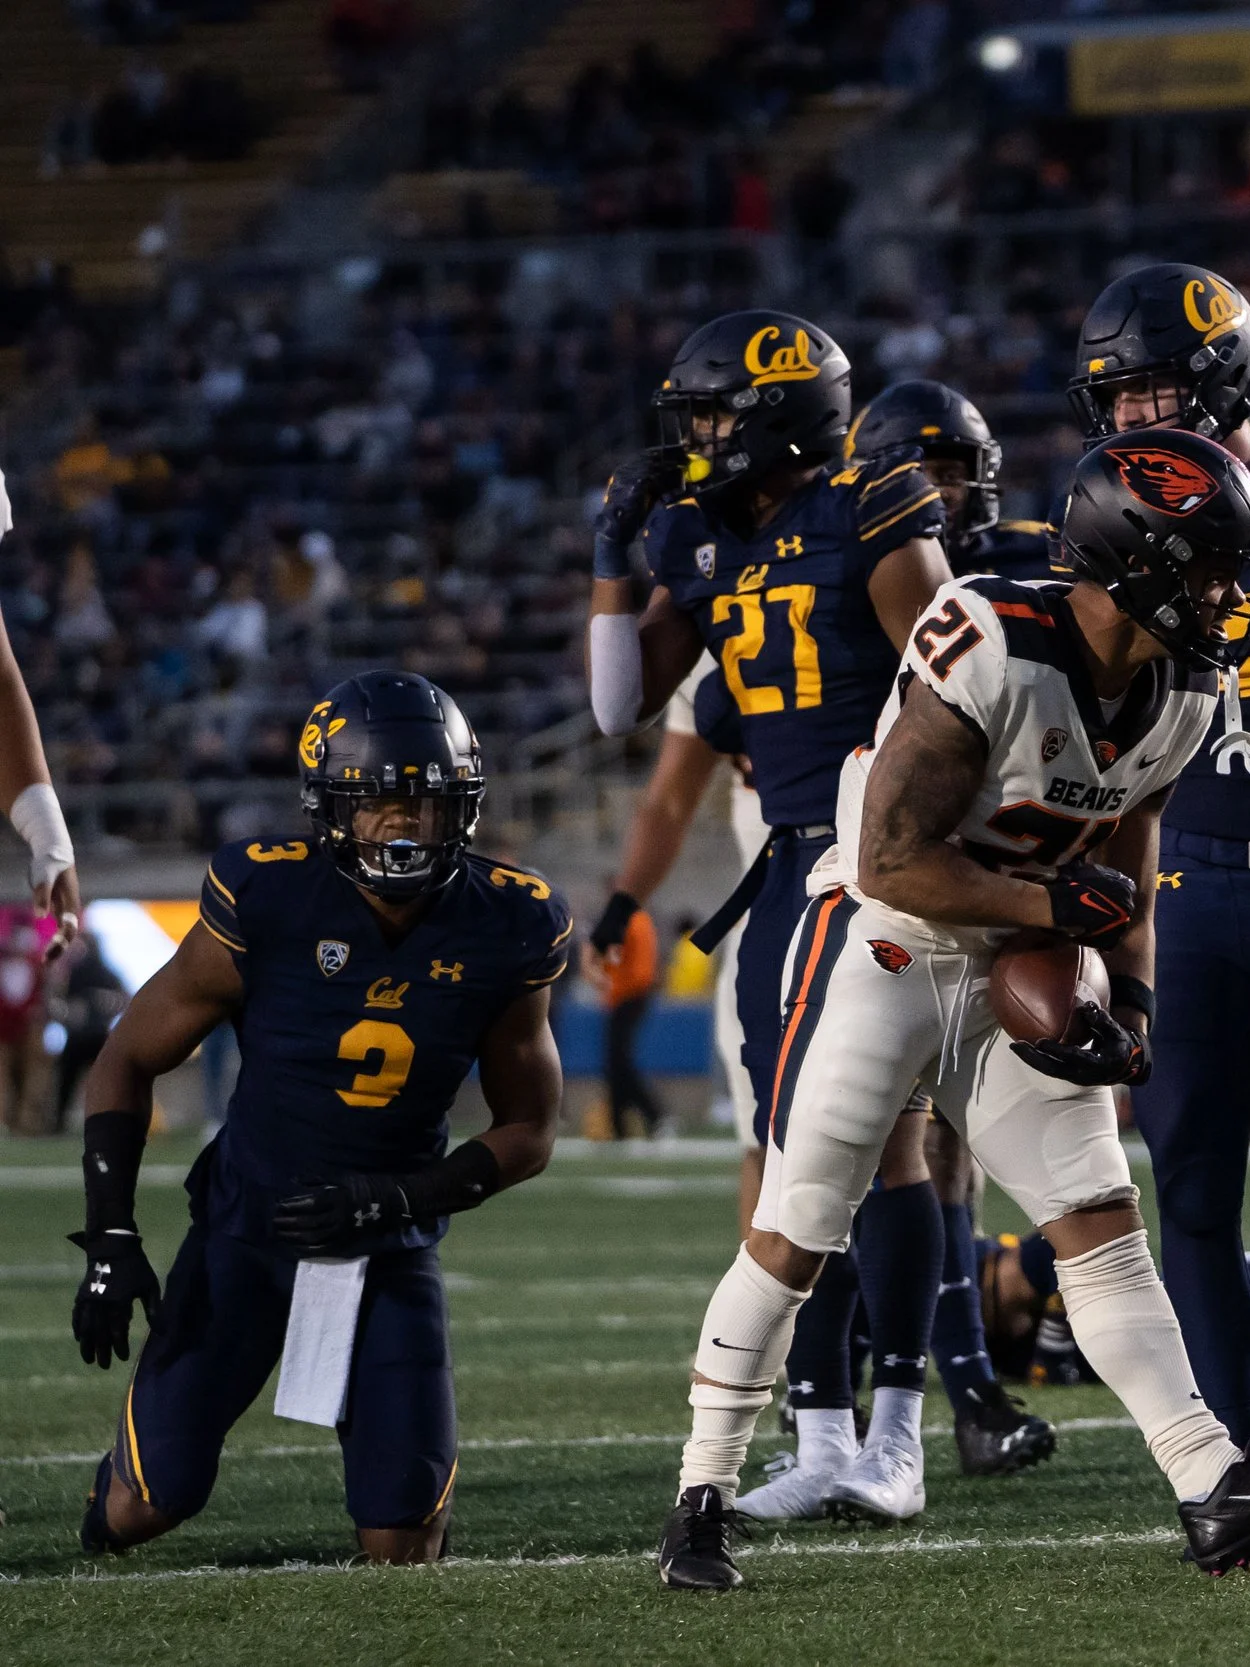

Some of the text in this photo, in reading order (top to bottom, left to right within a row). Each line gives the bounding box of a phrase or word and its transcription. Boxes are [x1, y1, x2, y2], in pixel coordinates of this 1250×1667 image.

[1183, 275, 1248, 344] Cal
[744, 325, 821, 387] Cal
[736, 564, 769, 595] Cal
[712, 584, 822, 716] 27
[913, 597, 985, 683] 21
[1043, 776, 1129, 812] BEAVS
[246, 841, 309, 863] 3
[489, 867, 551, 900] 3
[319, 942, 348, 965] PAC
[364, 976, 410, 1009] Cal
[334, 1019, 416, 1107] 3
